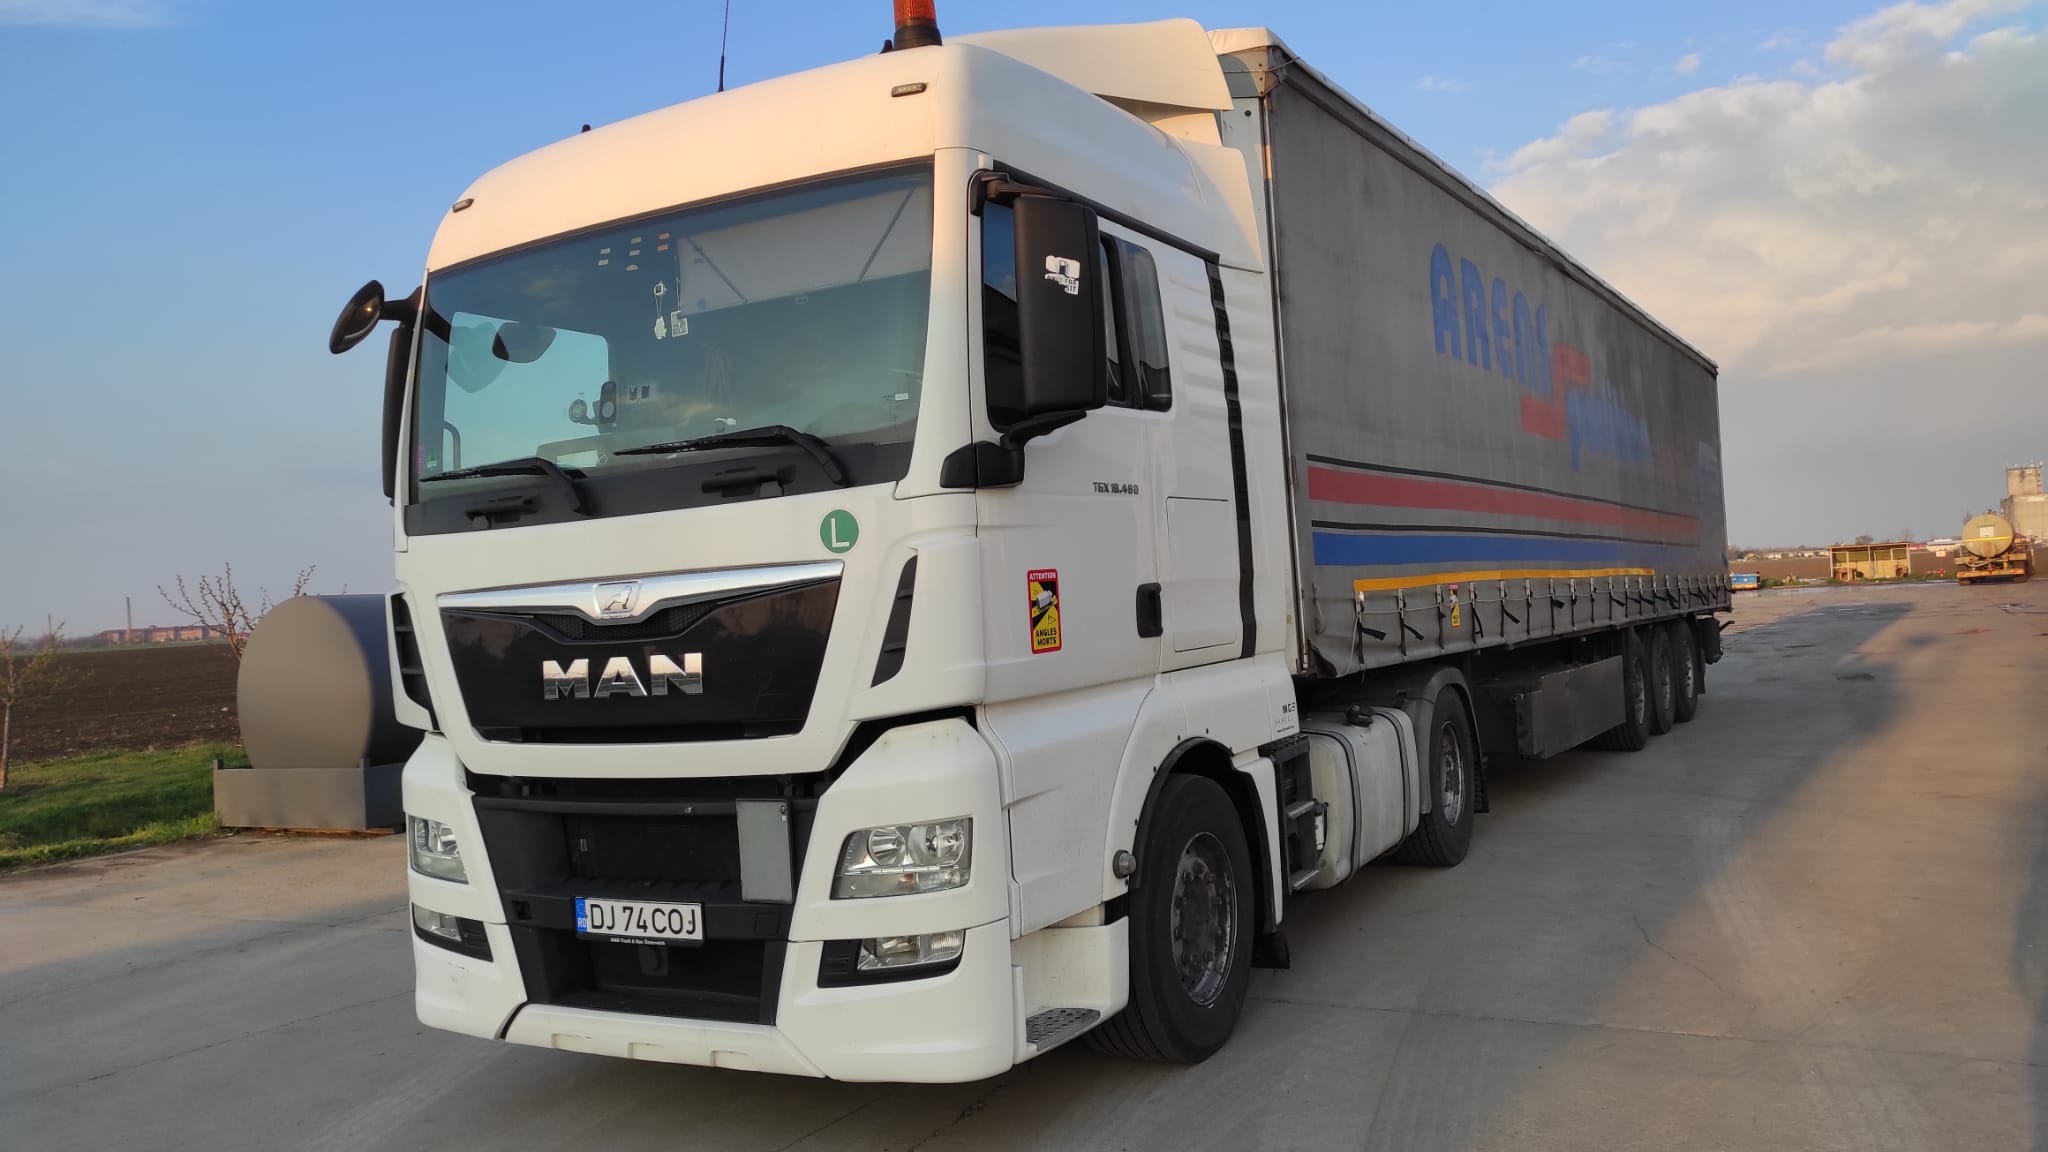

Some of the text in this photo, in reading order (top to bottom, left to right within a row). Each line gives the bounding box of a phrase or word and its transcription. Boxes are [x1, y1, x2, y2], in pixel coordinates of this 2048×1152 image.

[1092, 481, 1139, 495] TGX 18.480
[830, 517, 850, 548] L
[1035, 628, 1057, 637] ANGLES
[1036, 637, 1057, 647] MORTS
[543, 653, 703, 699] MAN
[590, 904, 615, 930] DJ
